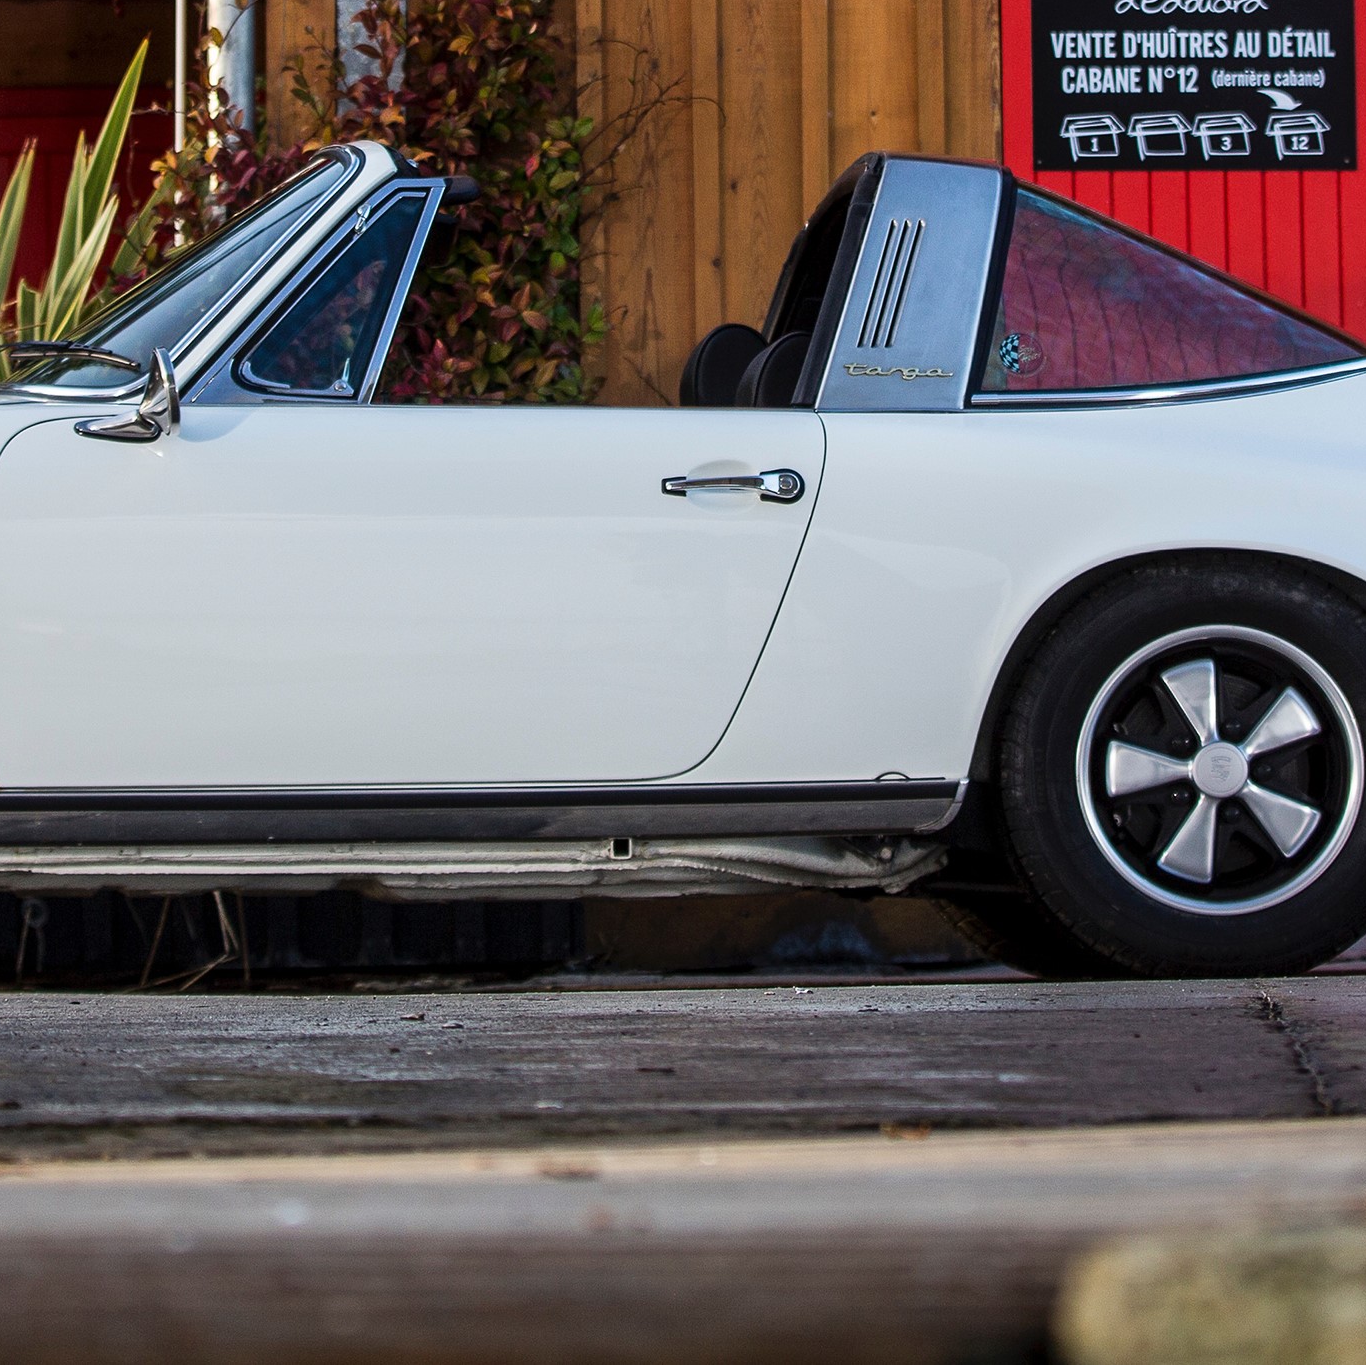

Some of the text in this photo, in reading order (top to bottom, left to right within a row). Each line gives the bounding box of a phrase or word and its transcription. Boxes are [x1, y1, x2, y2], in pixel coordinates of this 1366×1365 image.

[1050, 25, 1336, 59] VENTE D'HUÎTRES AU DÉTAIL
[1061, 66, 1326, 94] CABANE N°12 (dernière cabane)
[1090, 135, 1309, 152] 1 3 12
